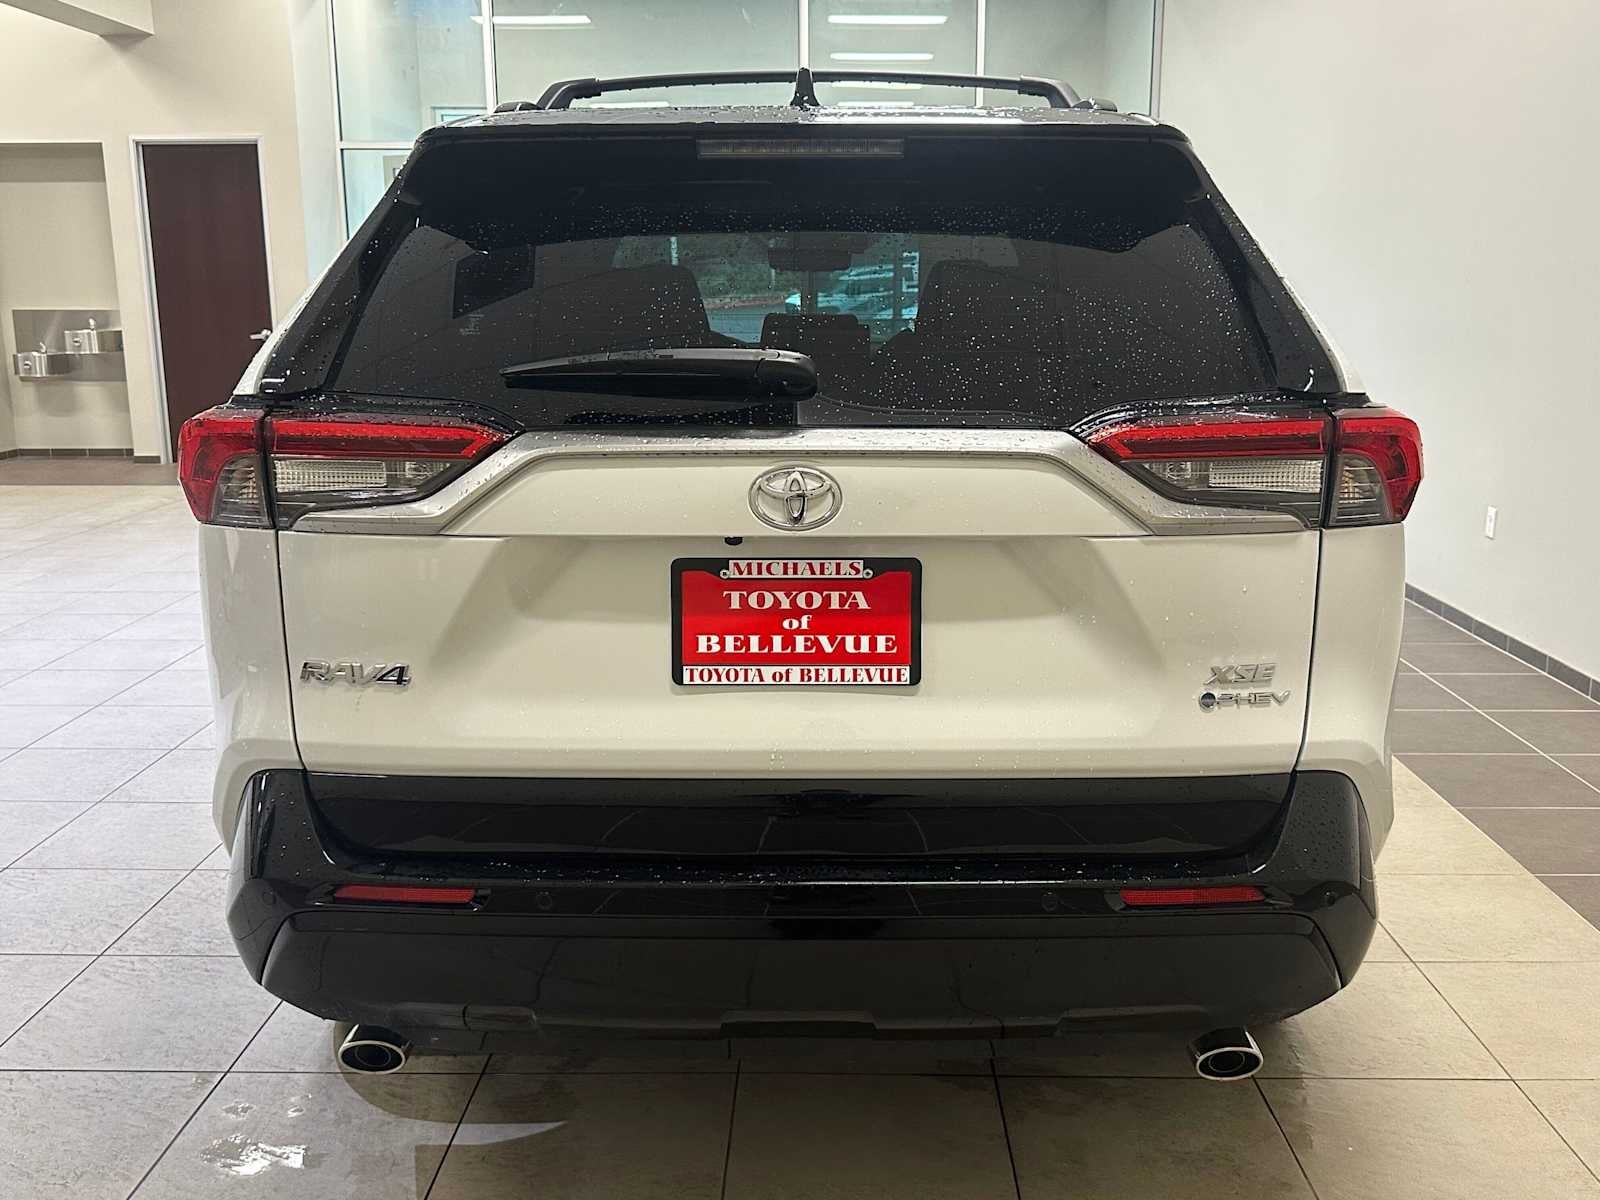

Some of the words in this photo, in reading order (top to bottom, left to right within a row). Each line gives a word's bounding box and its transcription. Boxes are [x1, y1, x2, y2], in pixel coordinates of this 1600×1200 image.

[732, 561, 862, 577] MICHAELS
[723, 590, 871, 610] TOYOTA
[782, 614, 813, 630] of
[696, 634, 898, 654] BELLEVUE
[300, 660, 411, 687] RAV4
[685, 667, 765, 683] TOYOTA
[772, 667, 794, 683] of
[801, 667, 908, 683] BELLEVUE
[1203, 662, 1277, 686] XSE
